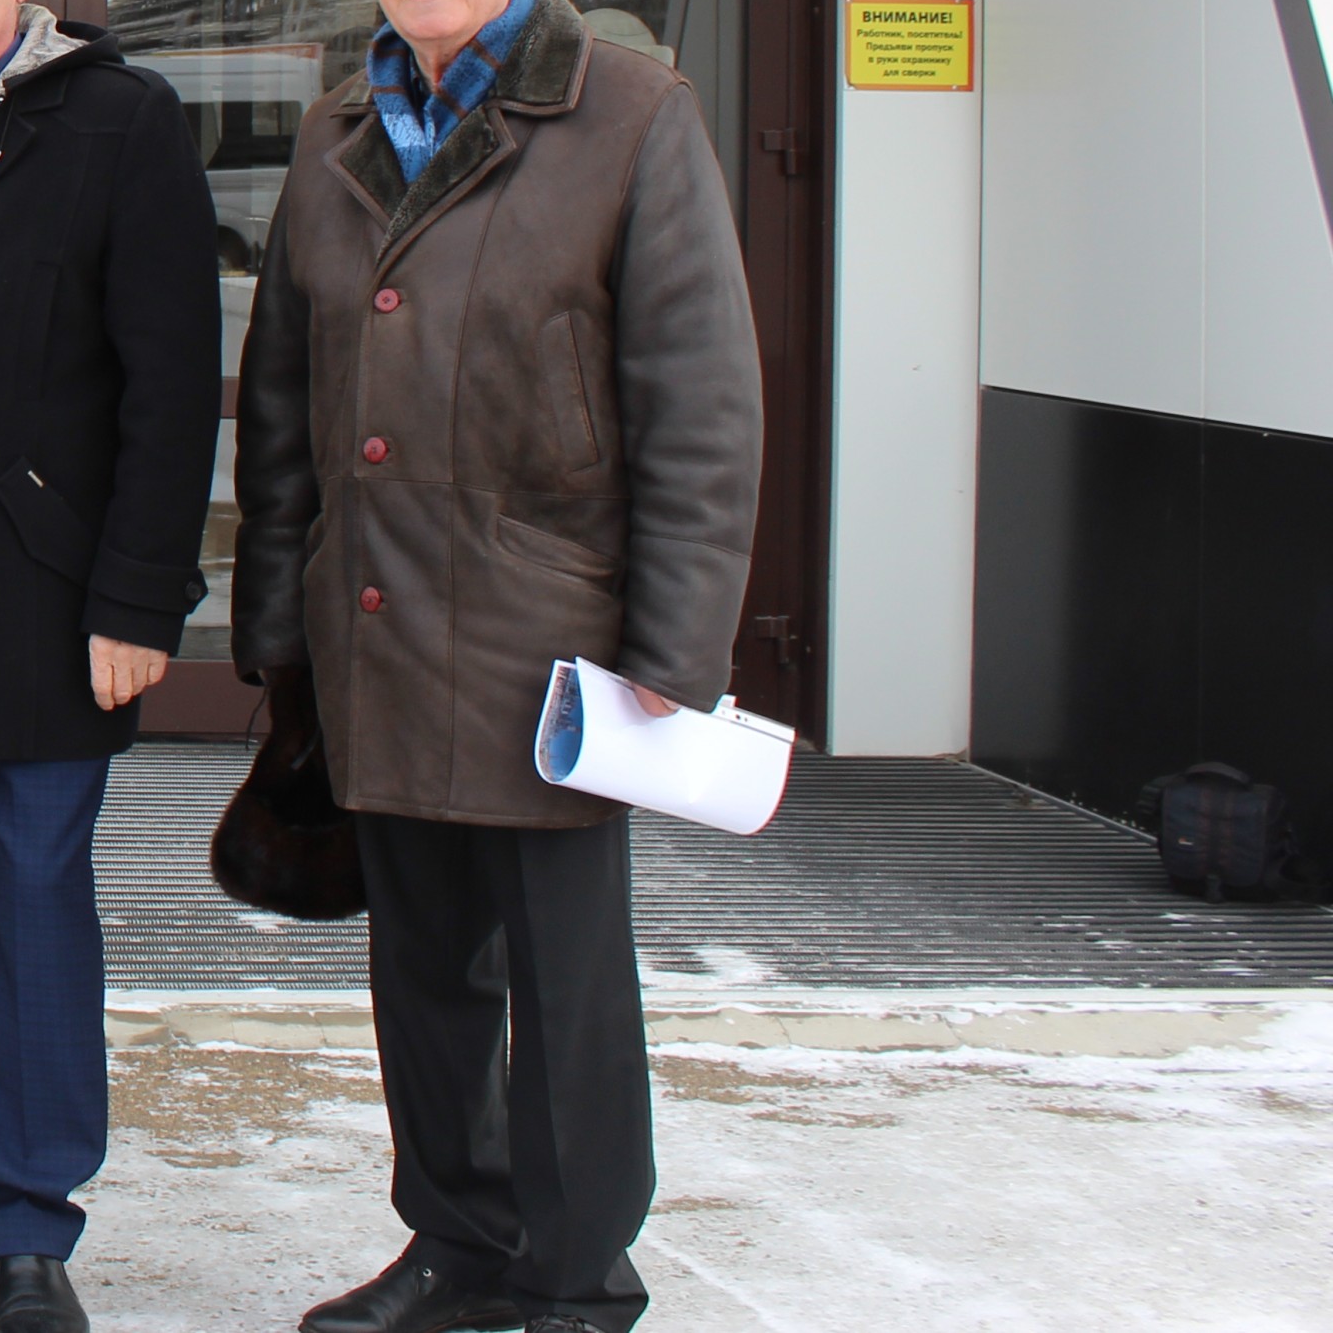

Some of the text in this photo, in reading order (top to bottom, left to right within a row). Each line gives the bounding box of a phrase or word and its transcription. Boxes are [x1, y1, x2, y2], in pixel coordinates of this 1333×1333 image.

[862, 10, 954, 24] ВНИМАНИЕ!
[856, 29, 964, 39] Работник, посетитель!
[865, 42, 955, 53] Предъяви пропуск
[876, 56, 900, 66] руки
[900, 56, 952, 65] охраннику
[882, 68, 937, 78] для сверки
